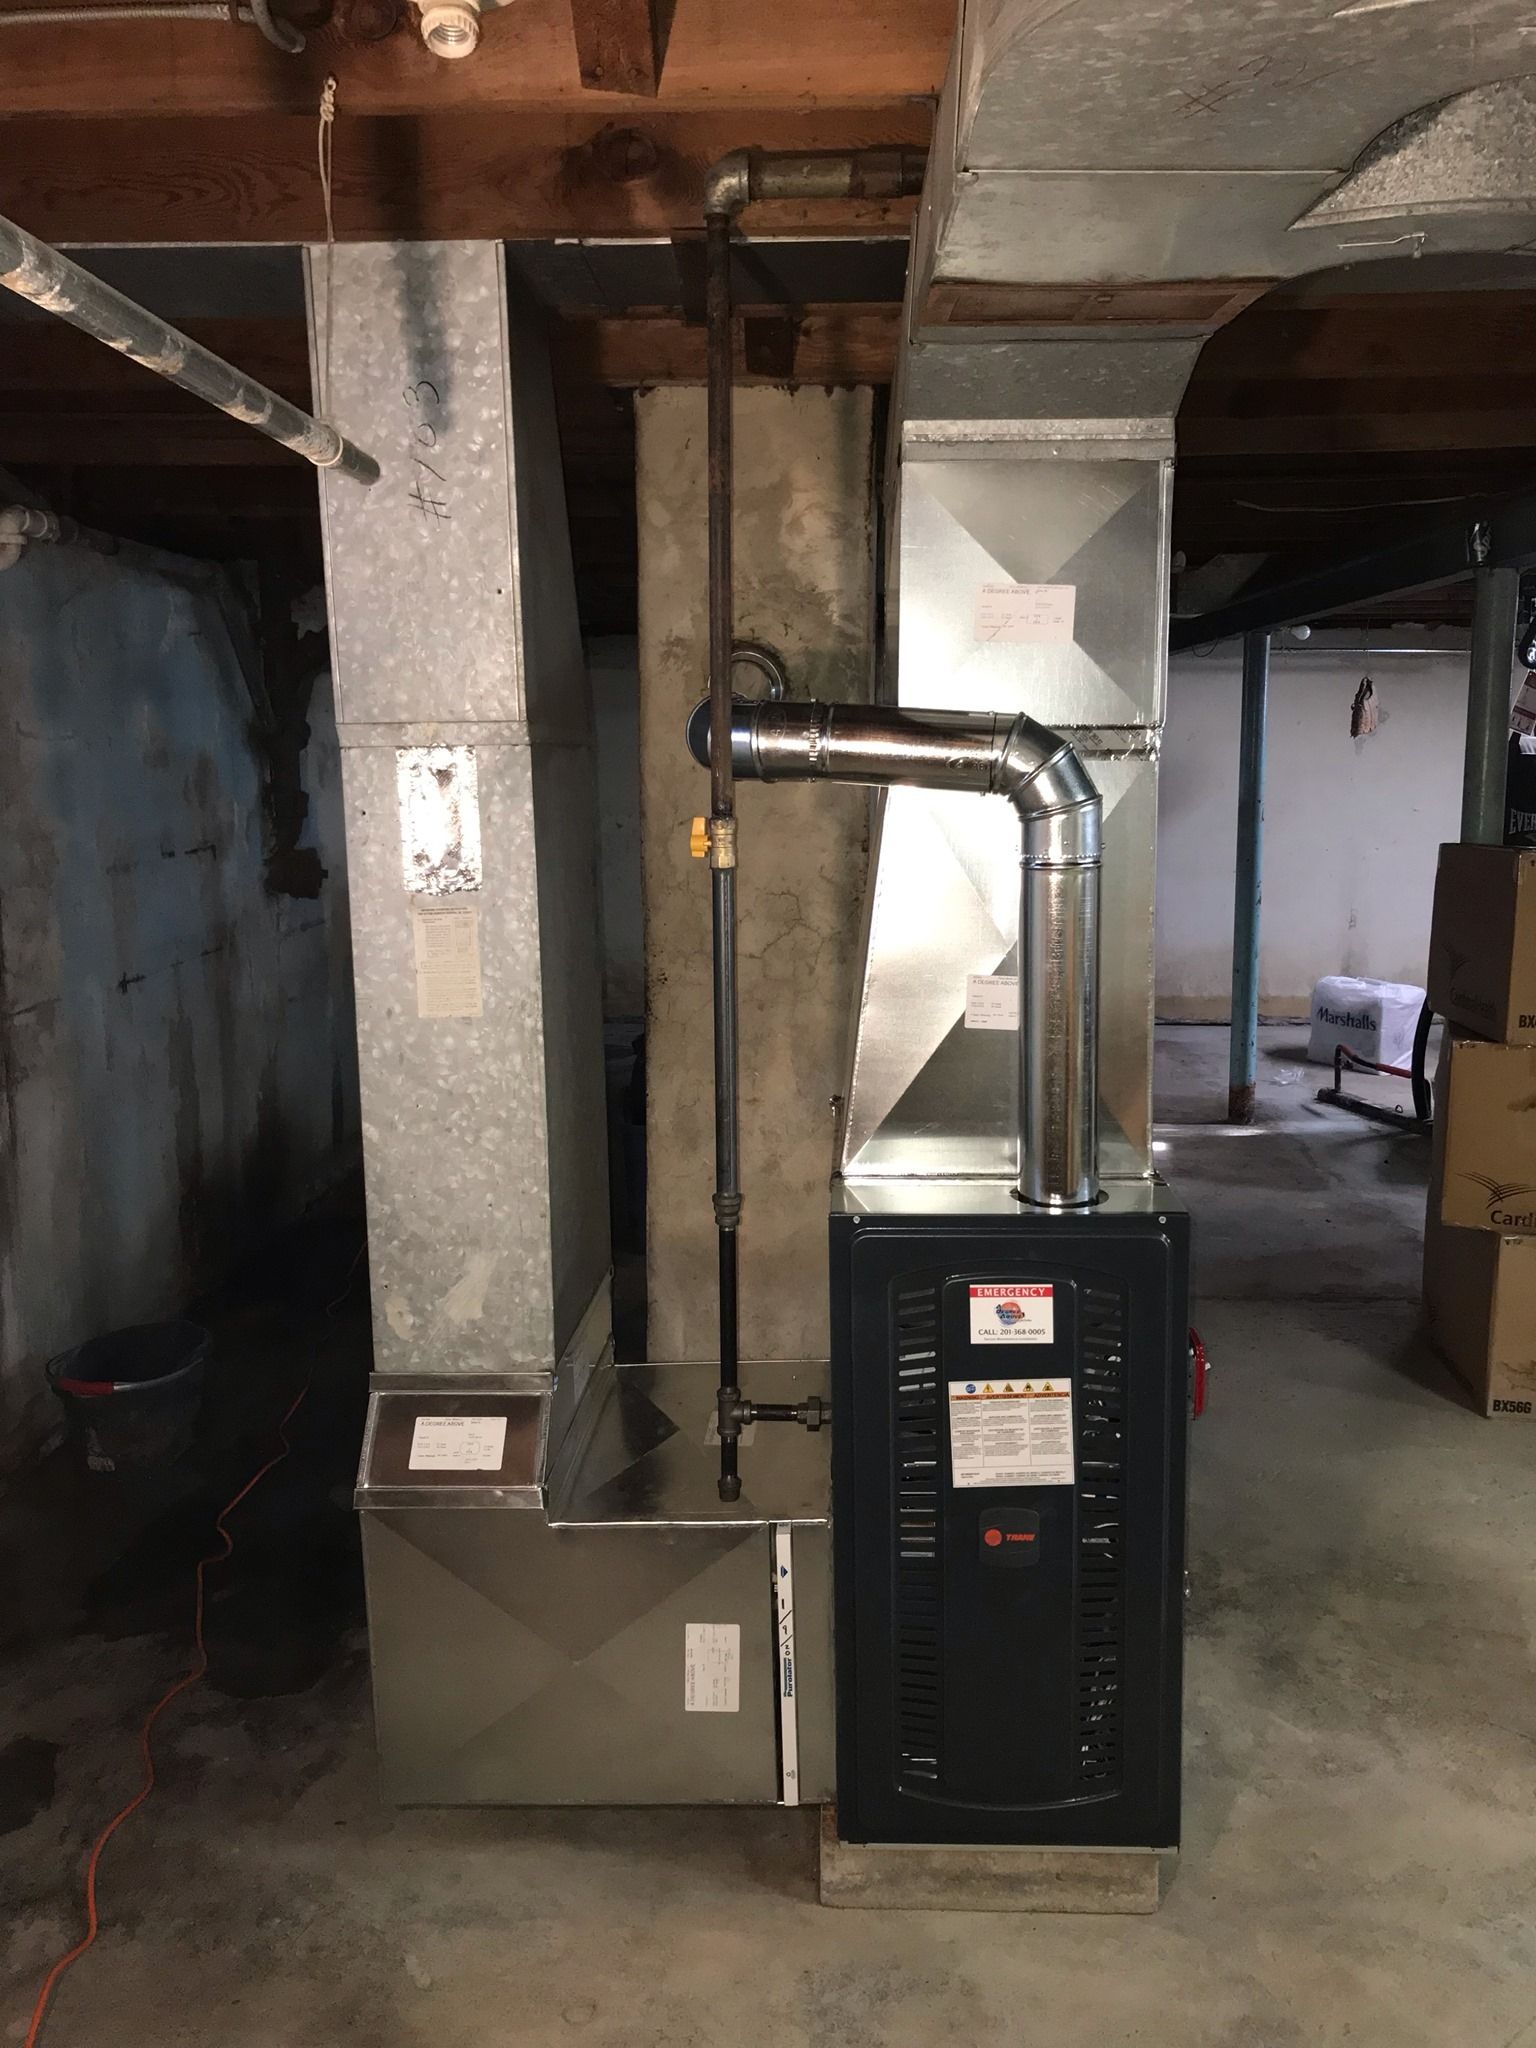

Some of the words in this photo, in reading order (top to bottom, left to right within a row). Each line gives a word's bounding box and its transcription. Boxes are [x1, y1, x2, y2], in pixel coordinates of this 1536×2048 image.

[1317, 1006, 1377, 1031] Marshalls
[1518, 1014, 1536, 1028] BX
[977, 1288, 1045, 1297] EMERGENCY
[978, 1328, 998, 1336] CALL:
[999, 1328, 1046, 1336] 201-368-0005
[1493, 1399, 1532, 1414] BX56G
